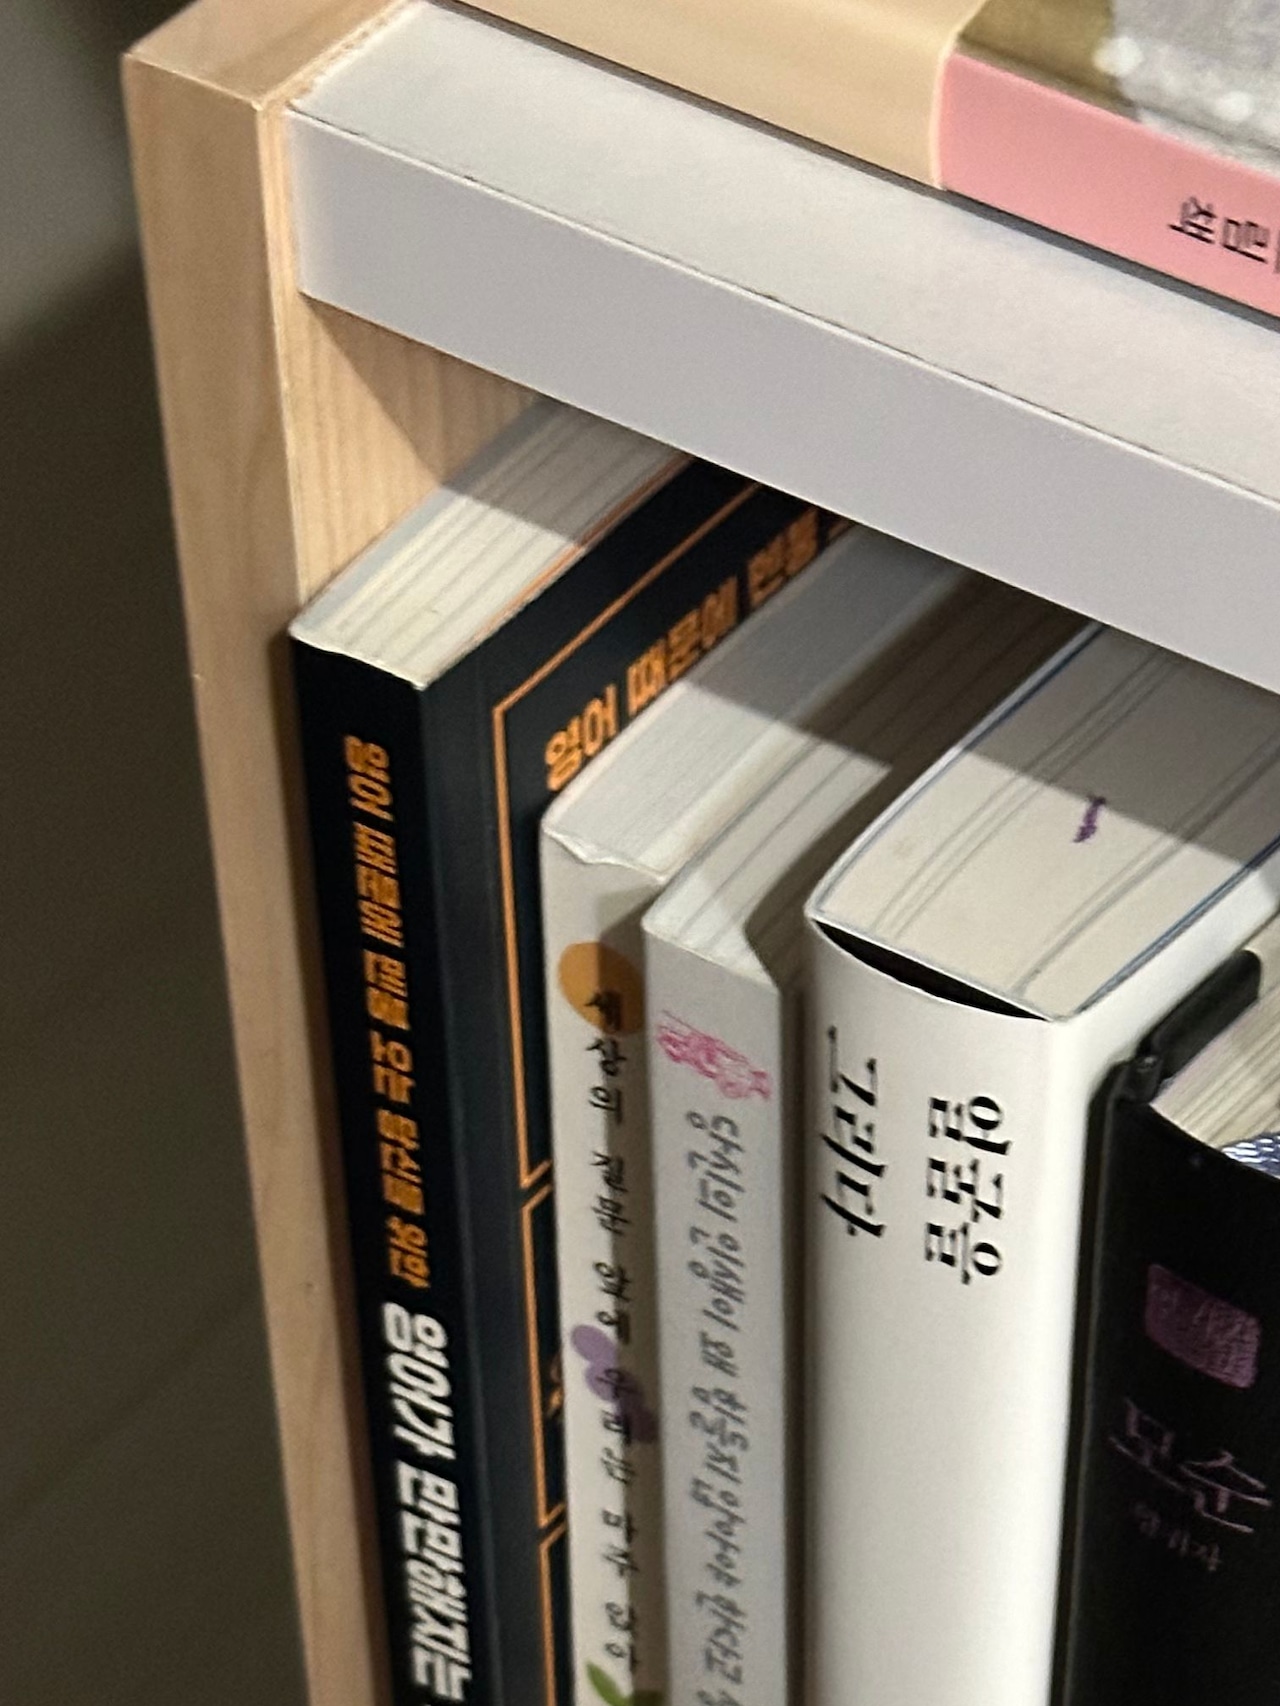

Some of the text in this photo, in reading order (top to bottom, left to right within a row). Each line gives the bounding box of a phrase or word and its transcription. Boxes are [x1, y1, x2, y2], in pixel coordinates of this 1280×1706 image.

[344, 735, 394, 822] 영어
[545, 681, 619, 794] 영어
[353, 821, 404, 948] 때문에
[370, 1030, 415, 1104] 오는
[685, 1110, 746, 1223] 당신의
[820, 1025, 1013, 1286] 얼굴을 그리다
[687, 1225, 746, 1335] 인생이
[383, 1302, 456, 1460] 영어가
[698, 1330, 738, 1378] 왜
[688, 1385, 750, 1490] 힘들지
[1108, 1396, 1274, 1535] 모순
[397, 1461, 471, 1700] 만만해지는
